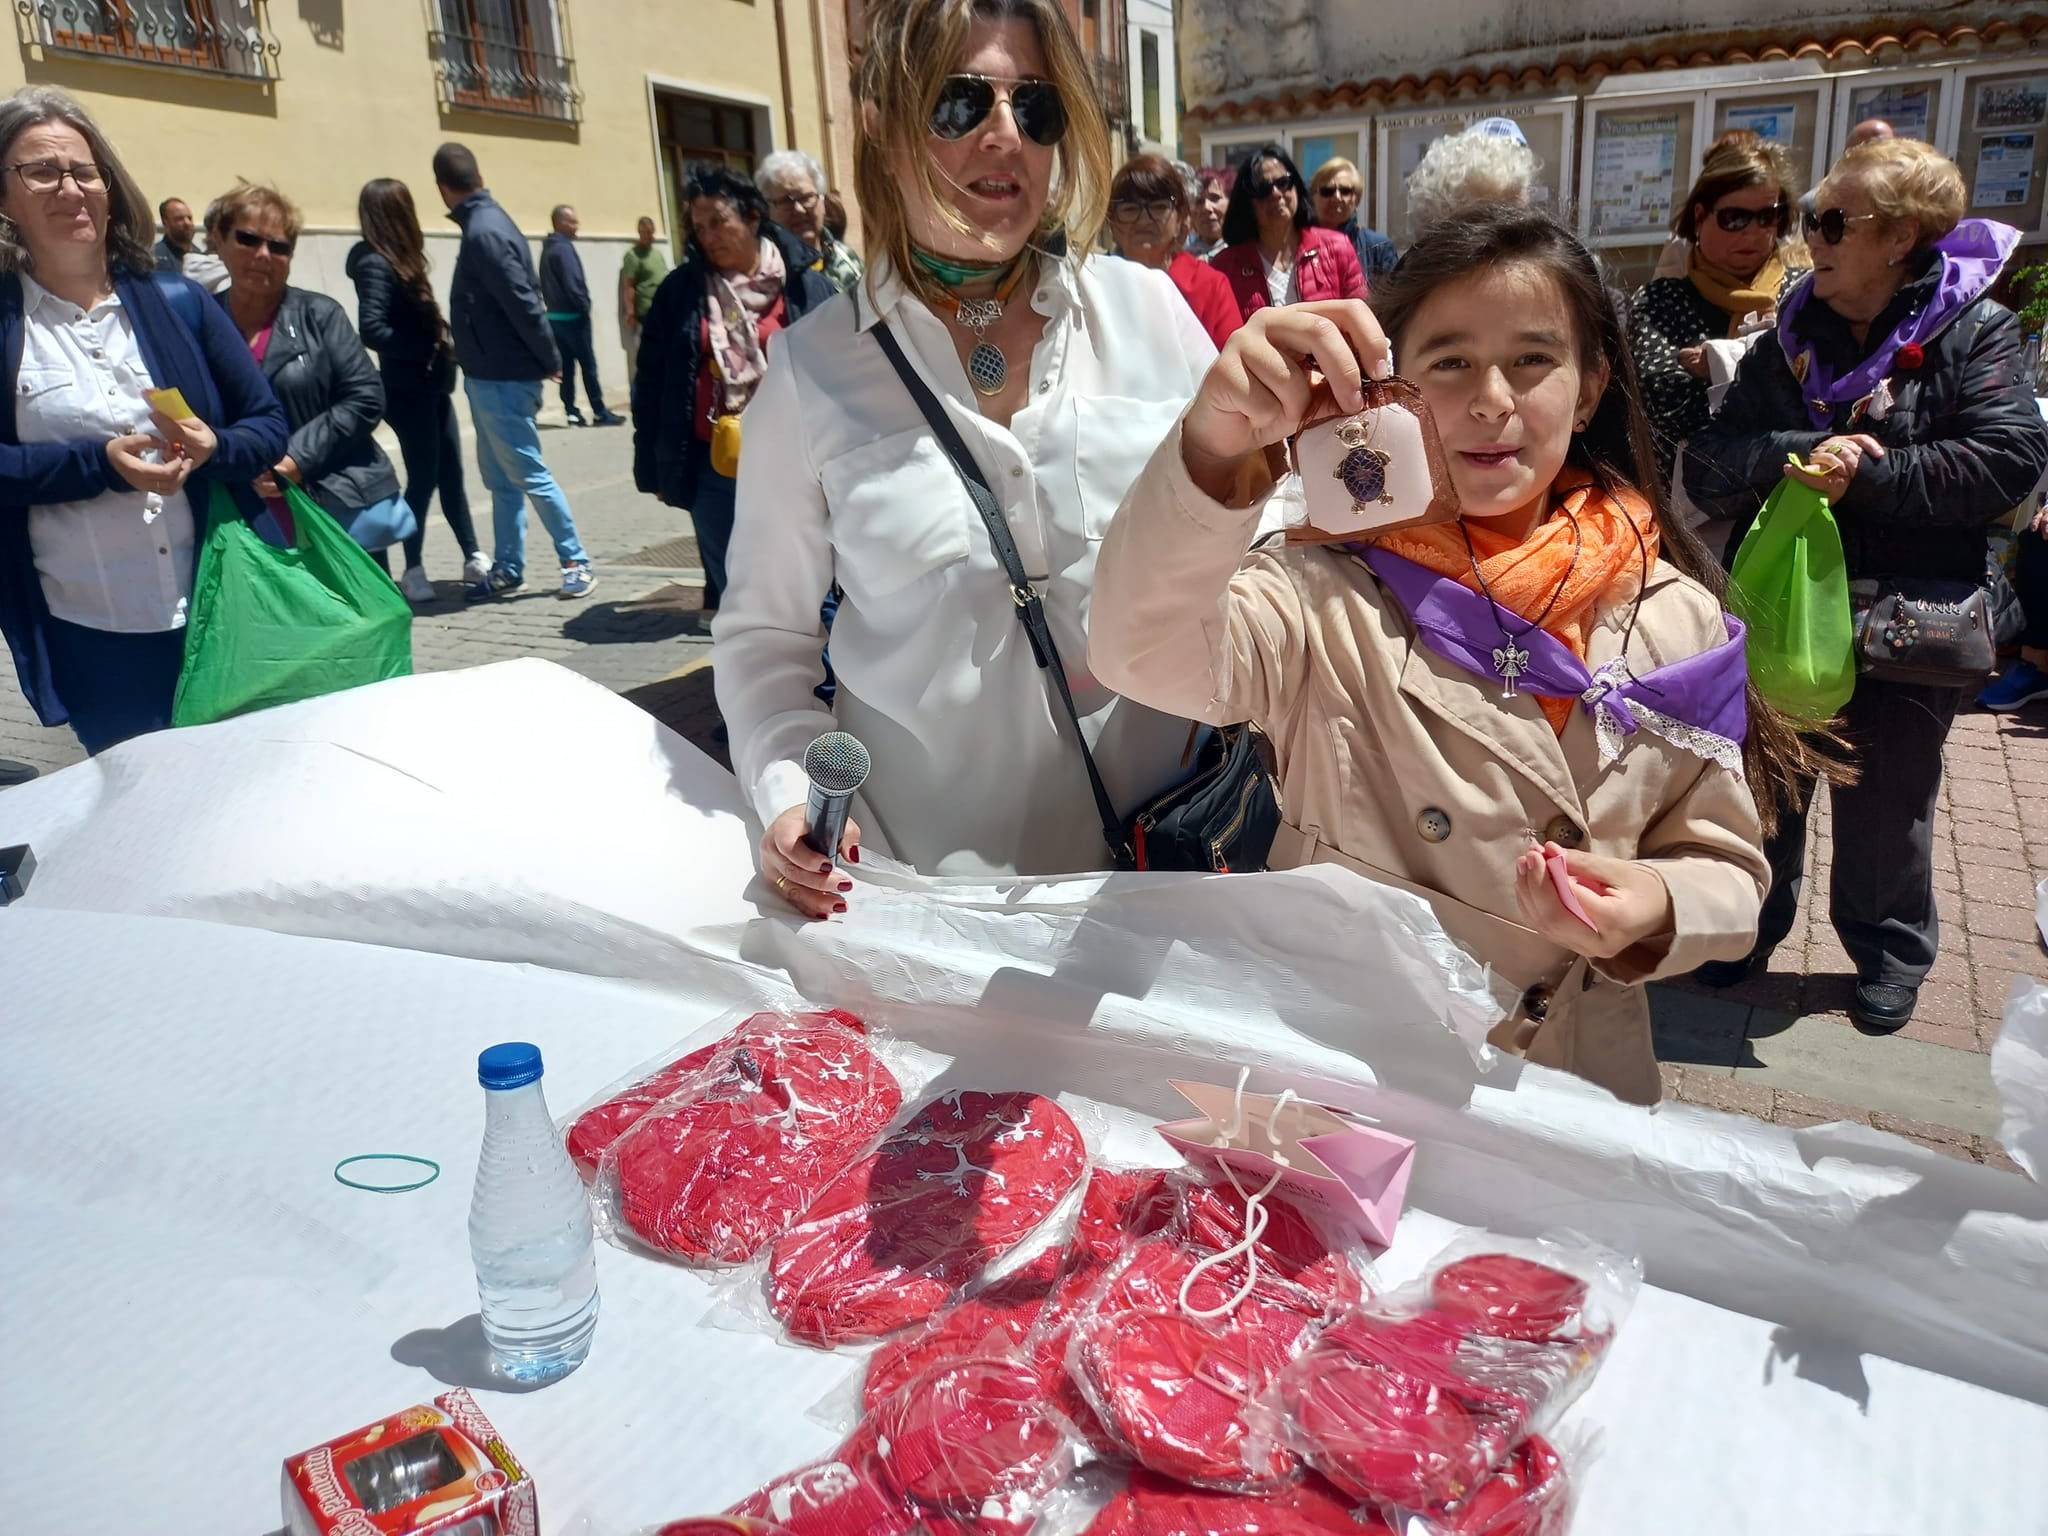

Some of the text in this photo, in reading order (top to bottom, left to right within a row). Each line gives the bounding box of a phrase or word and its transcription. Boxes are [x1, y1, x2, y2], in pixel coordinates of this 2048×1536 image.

[1382, 118, 1410, 129] AMAS
[1414, 117, 1425, 127] DE
[1431, 114, 1460, 124] CASA
